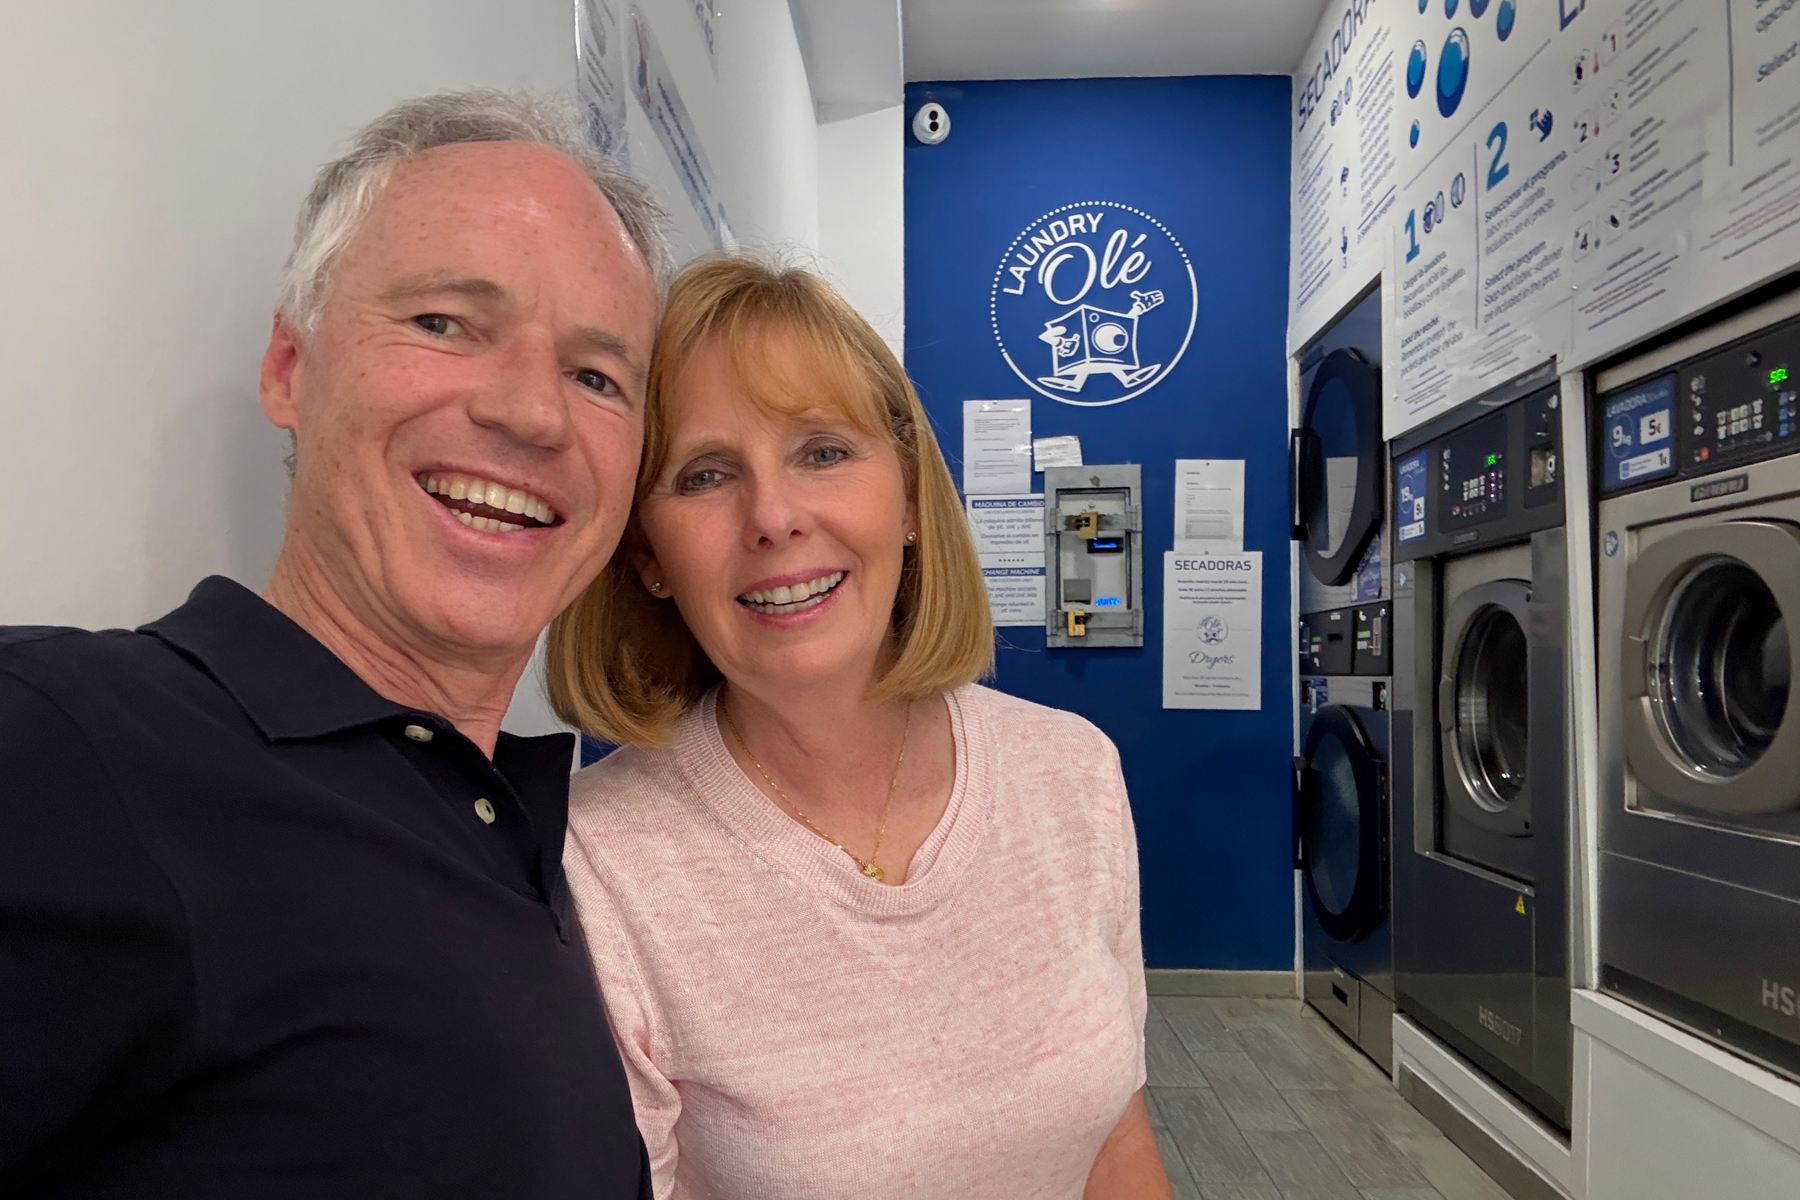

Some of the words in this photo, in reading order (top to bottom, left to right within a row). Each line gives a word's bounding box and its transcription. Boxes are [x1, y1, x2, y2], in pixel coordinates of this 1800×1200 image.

[1486, 121, 1510, 192] 2
[1003, 213, 1104, 295] LAUNDRY
[1038, 228, 1152, 305] Olé
[1405, 208, 1420, 265] 1
[1175, 560, 1252, 571] SECADORAS
[1189, 651, 1235, 670] Dryers
